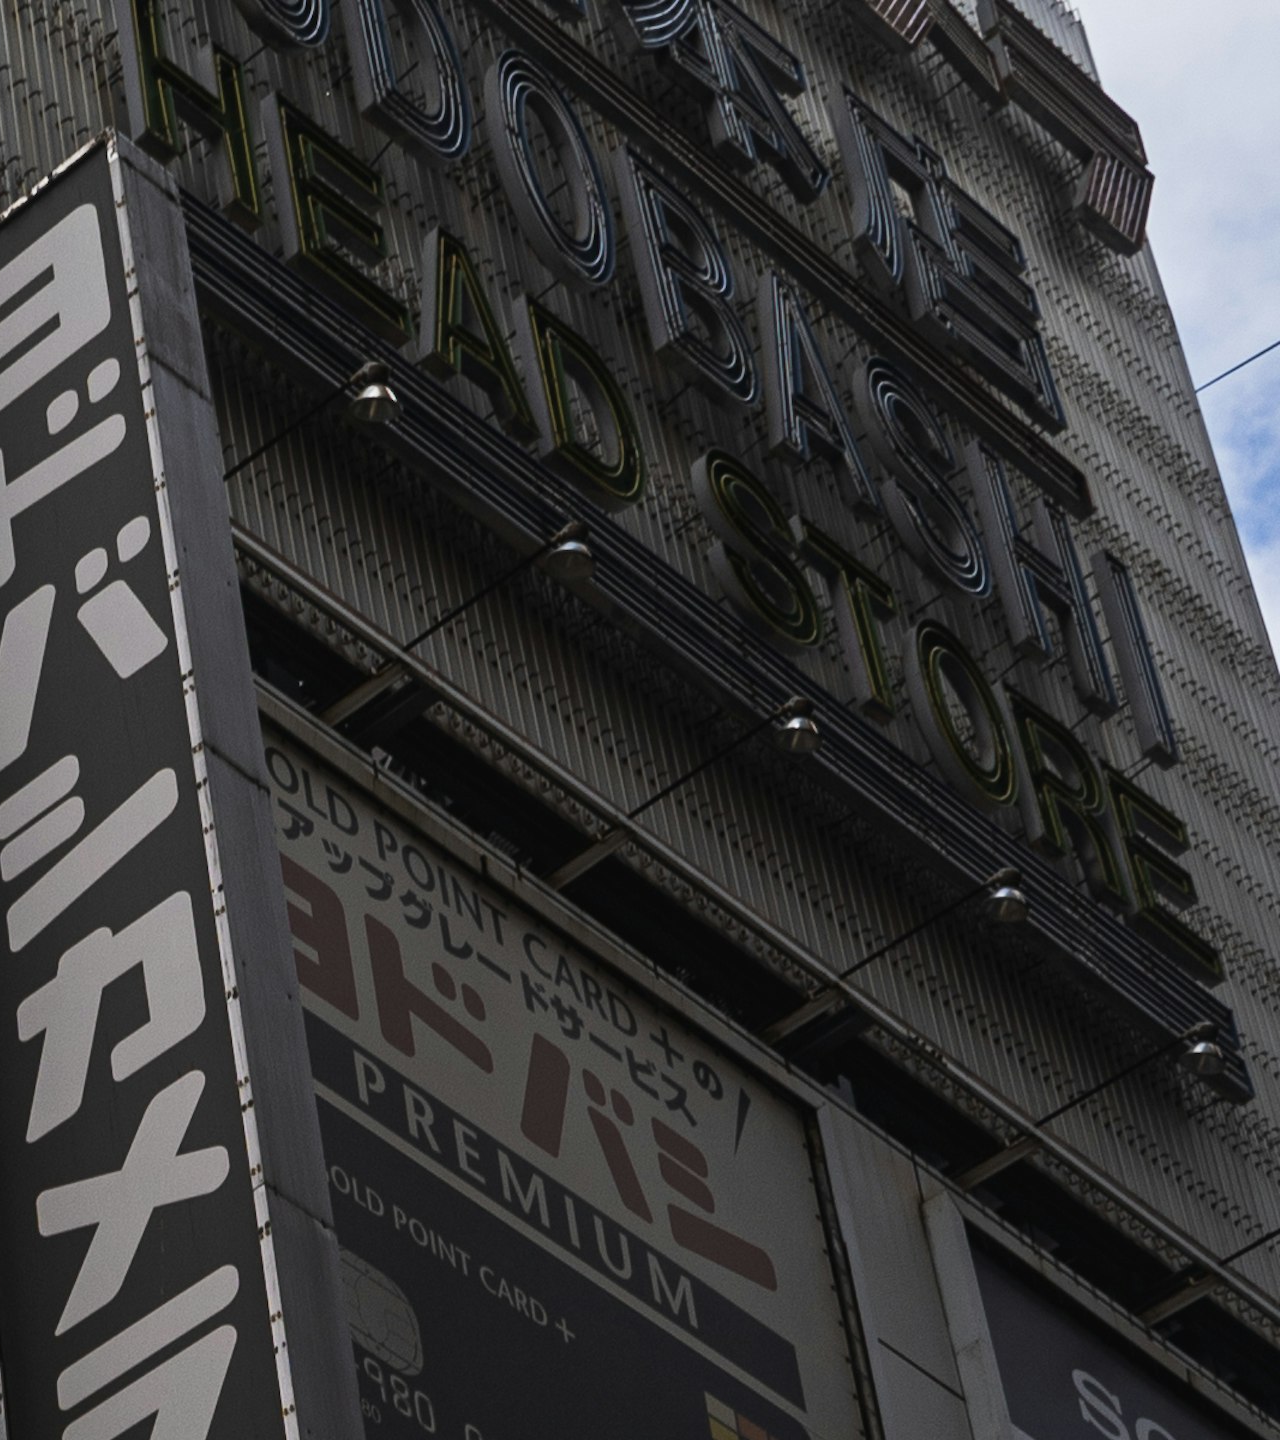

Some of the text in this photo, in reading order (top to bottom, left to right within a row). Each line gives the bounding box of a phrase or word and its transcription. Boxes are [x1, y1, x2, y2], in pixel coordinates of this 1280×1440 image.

[692, 445, 1223, 985] STORE
[265, 747, 360, 836] OLD
[374, 818, 507, 945] POINT
[523, 933, 638, 1036] CARD
[280, 852, 778, 1292] ヨドバシ
[352, 1048, 698, 1322] PREMIUM
[328, 1163, 385, 1218] OLD
[393, 1201, 472, 1278] POINT
[480, 1263, 548, 1326] CARD
[356, 1356, 436, 1434] 980
